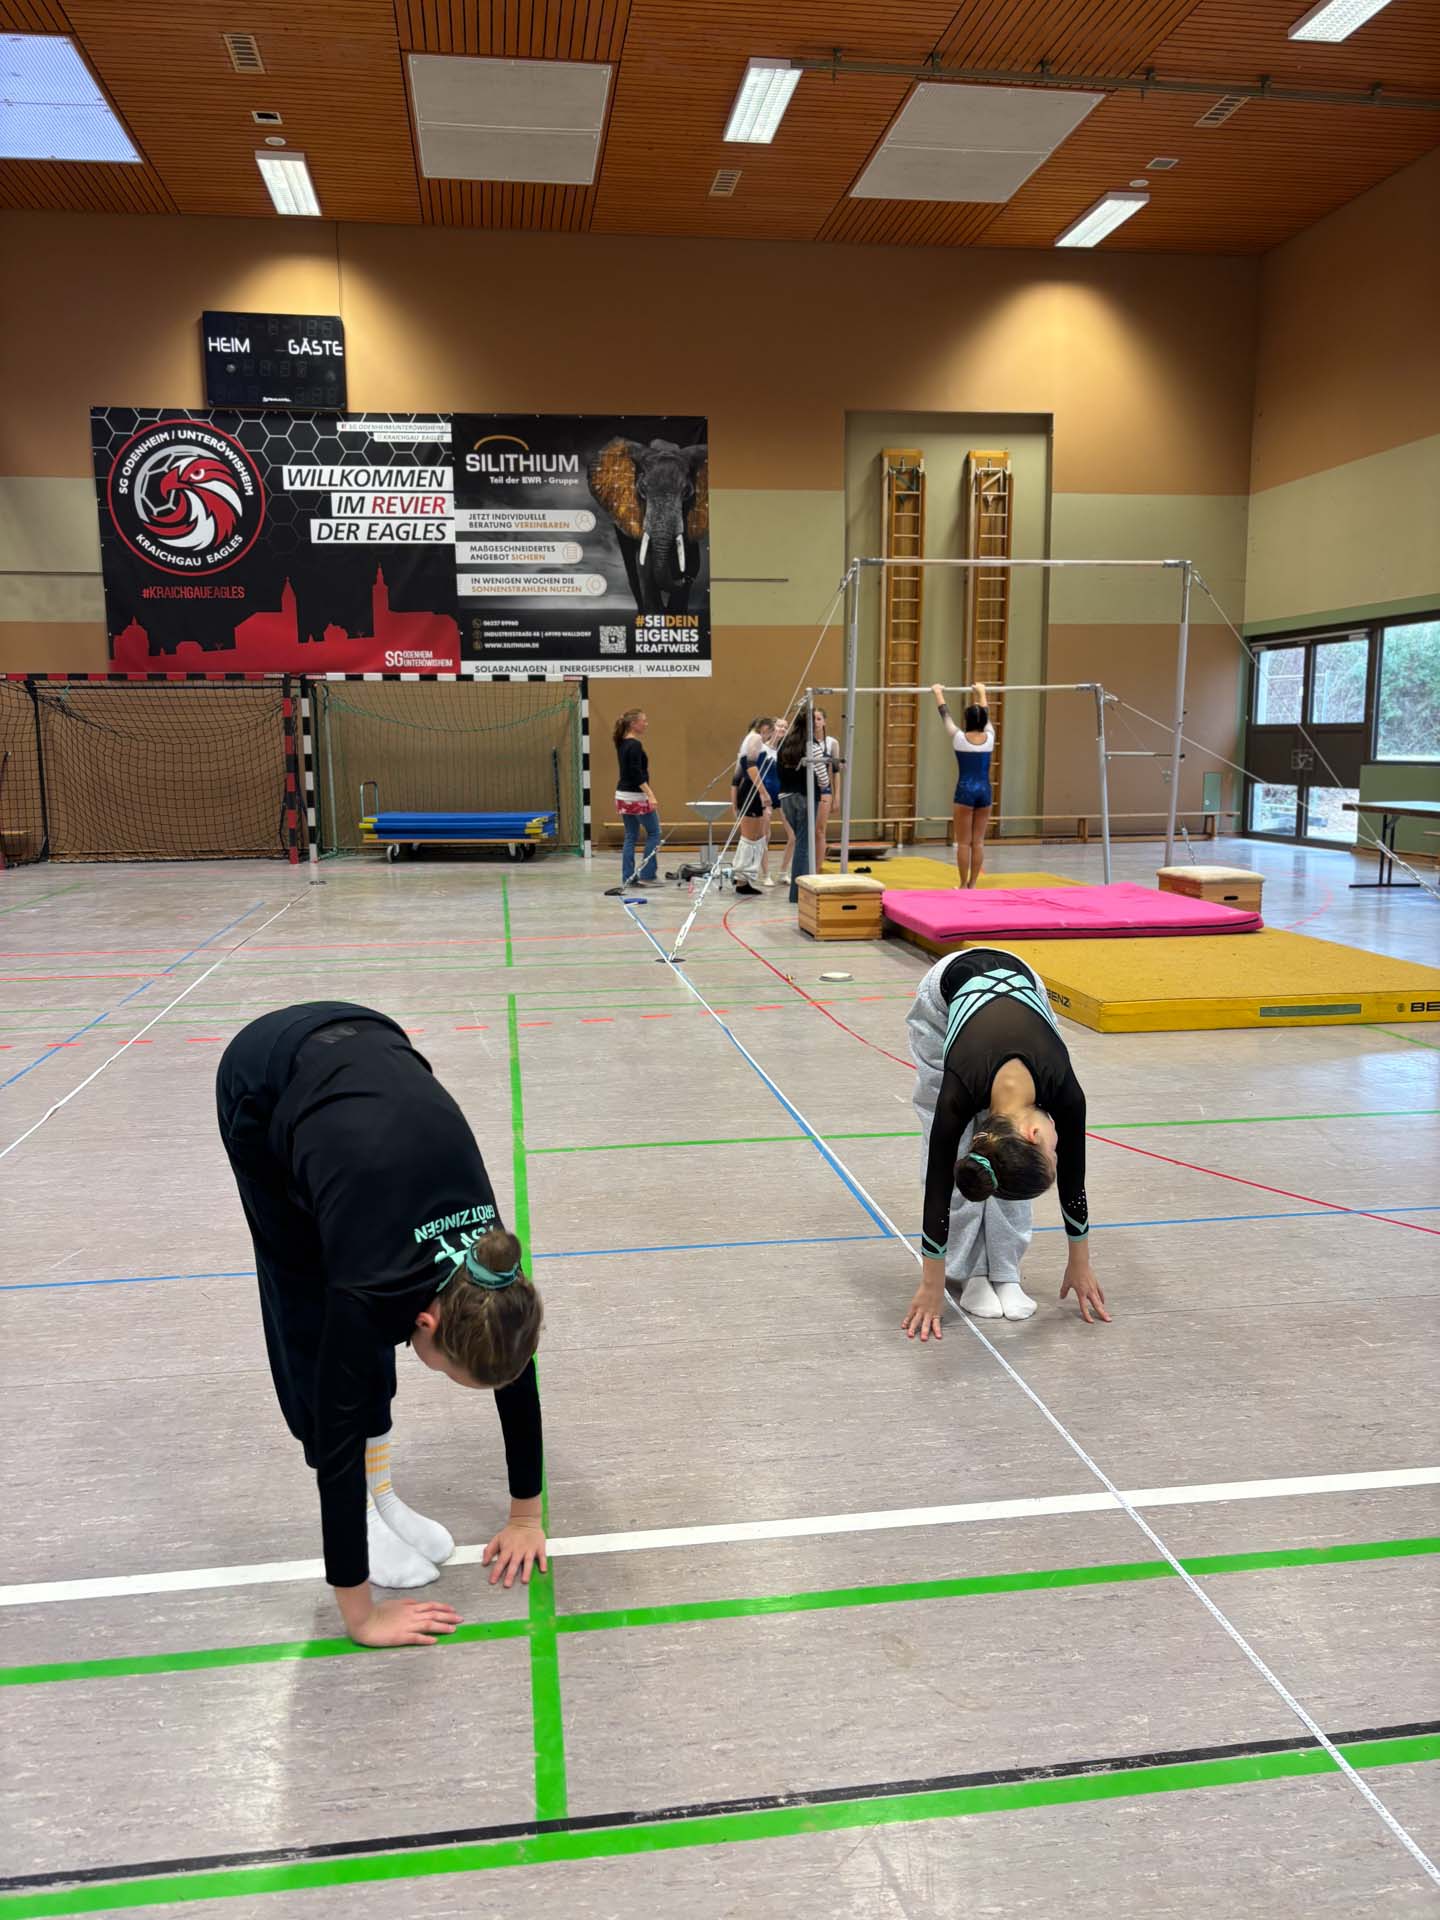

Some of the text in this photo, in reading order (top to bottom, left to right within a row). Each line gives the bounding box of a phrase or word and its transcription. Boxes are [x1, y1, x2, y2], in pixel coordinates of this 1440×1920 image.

[208, 337, 343, 356] HEIM GÄSTE
[119, 478, 129, 495] SG
[124, 430, 170, 477] ODENHEIM
[177, 429, 254, 496] UNTERÖWISHEIM
[465, 453, 579, 472] SILITHIUM
[287, 469, 445, 488] WILLKOMMEN
[489, 476, 504, 484] Teil
[505, 476, 520, 484] der
[522, 476, 541, 484] EWR
[548, 477, 579, 486] Gruppe
[337, 496, 447, 514] IM REVIER
[317, 523, 447, 541] DER EAGLES
[135, 533, 244, 566] KRAICHGAU EAGLES
[142, 586, 245, 599] #KRAICHGAUEAGLES
[635, 615, 699, 627] #SEIDEIN
[635, 629, 699, 642] EIGENES
[635, 643, 699, 653] KRAFTWERK
[385, 650, 433, 667] SG ODENHEIM
[475, 664, 700, 673] SOLARANLAGEN ENERGIESPEICHER WALLBOXEN
[414, 1204, 496, 1243] GRÖTZINGEN
